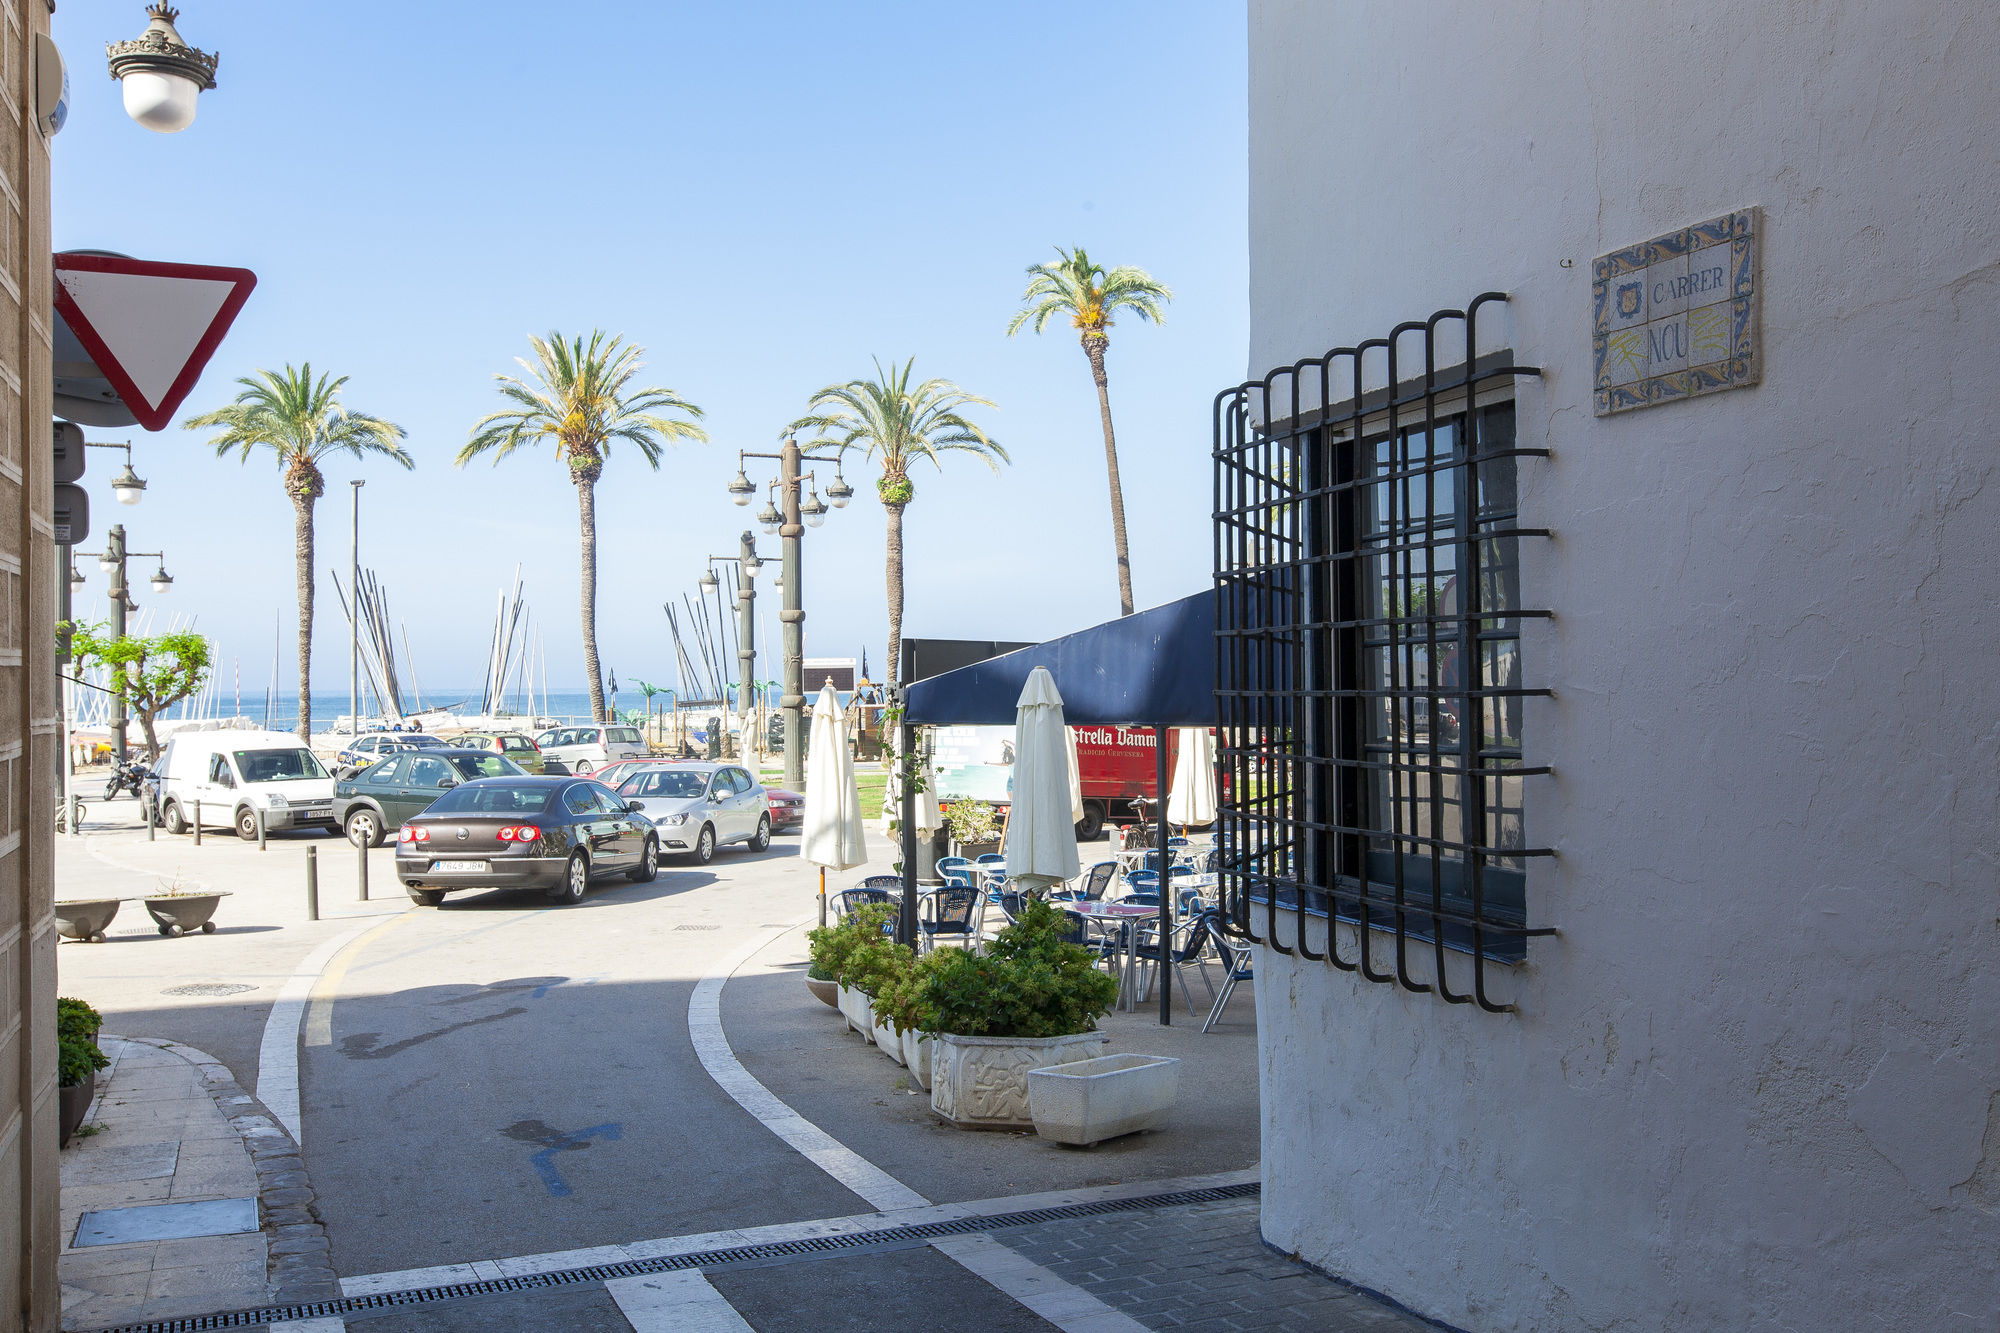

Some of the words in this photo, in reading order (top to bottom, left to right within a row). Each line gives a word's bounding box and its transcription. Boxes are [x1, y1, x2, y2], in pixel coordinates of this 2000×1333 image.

[1653, 266, 1723, 304] CARRER
[1649, 322, 1687, 364] NOU
[1073, 727, 1112, 746] strella
[1115, 726, 1156, 747] Damm
